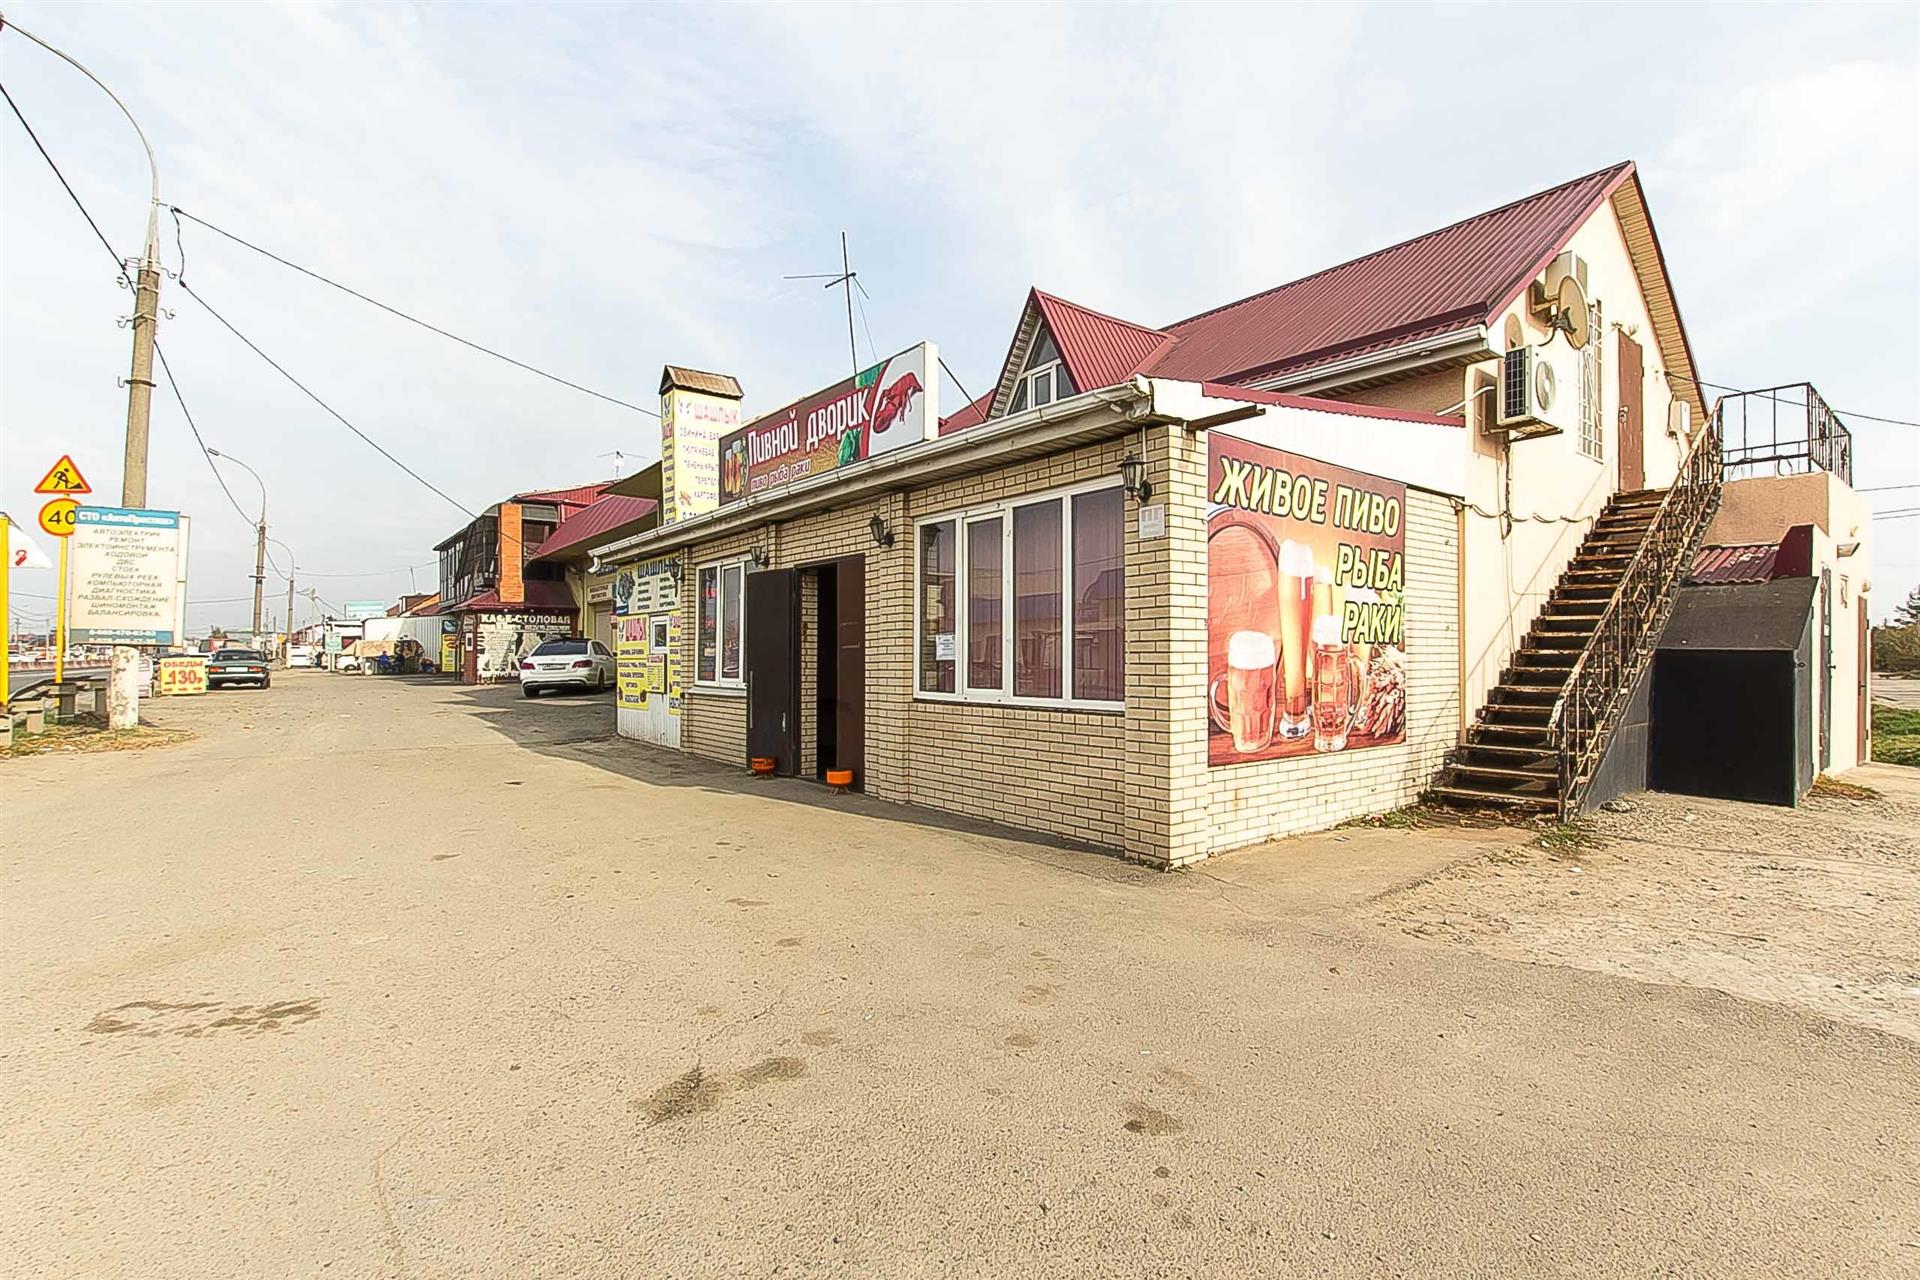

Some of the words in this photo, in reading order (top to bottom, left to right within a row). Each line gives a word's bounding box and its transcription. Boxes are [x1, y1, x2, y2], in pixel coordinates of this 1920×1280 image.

[748, 408, 799, 467] Пивной
[751, 475, 768, 493] пиво
[769, 464, 789, 488] рыба
[790, 459, 812, 480] раки
[1213, 455, 1329, 525] ЖИВОЕ
[1332, 483, 1401, 538] ПИВО
[47, 510, 76, 525] 40
[637, 554, 678, 579] ШАШЛЫ
[1335, 543, 1403, 592] РЫБА
[1341, 600, 1402, 645] РАКИ
[163, 660, 204, 668] ОБЕДЫ
